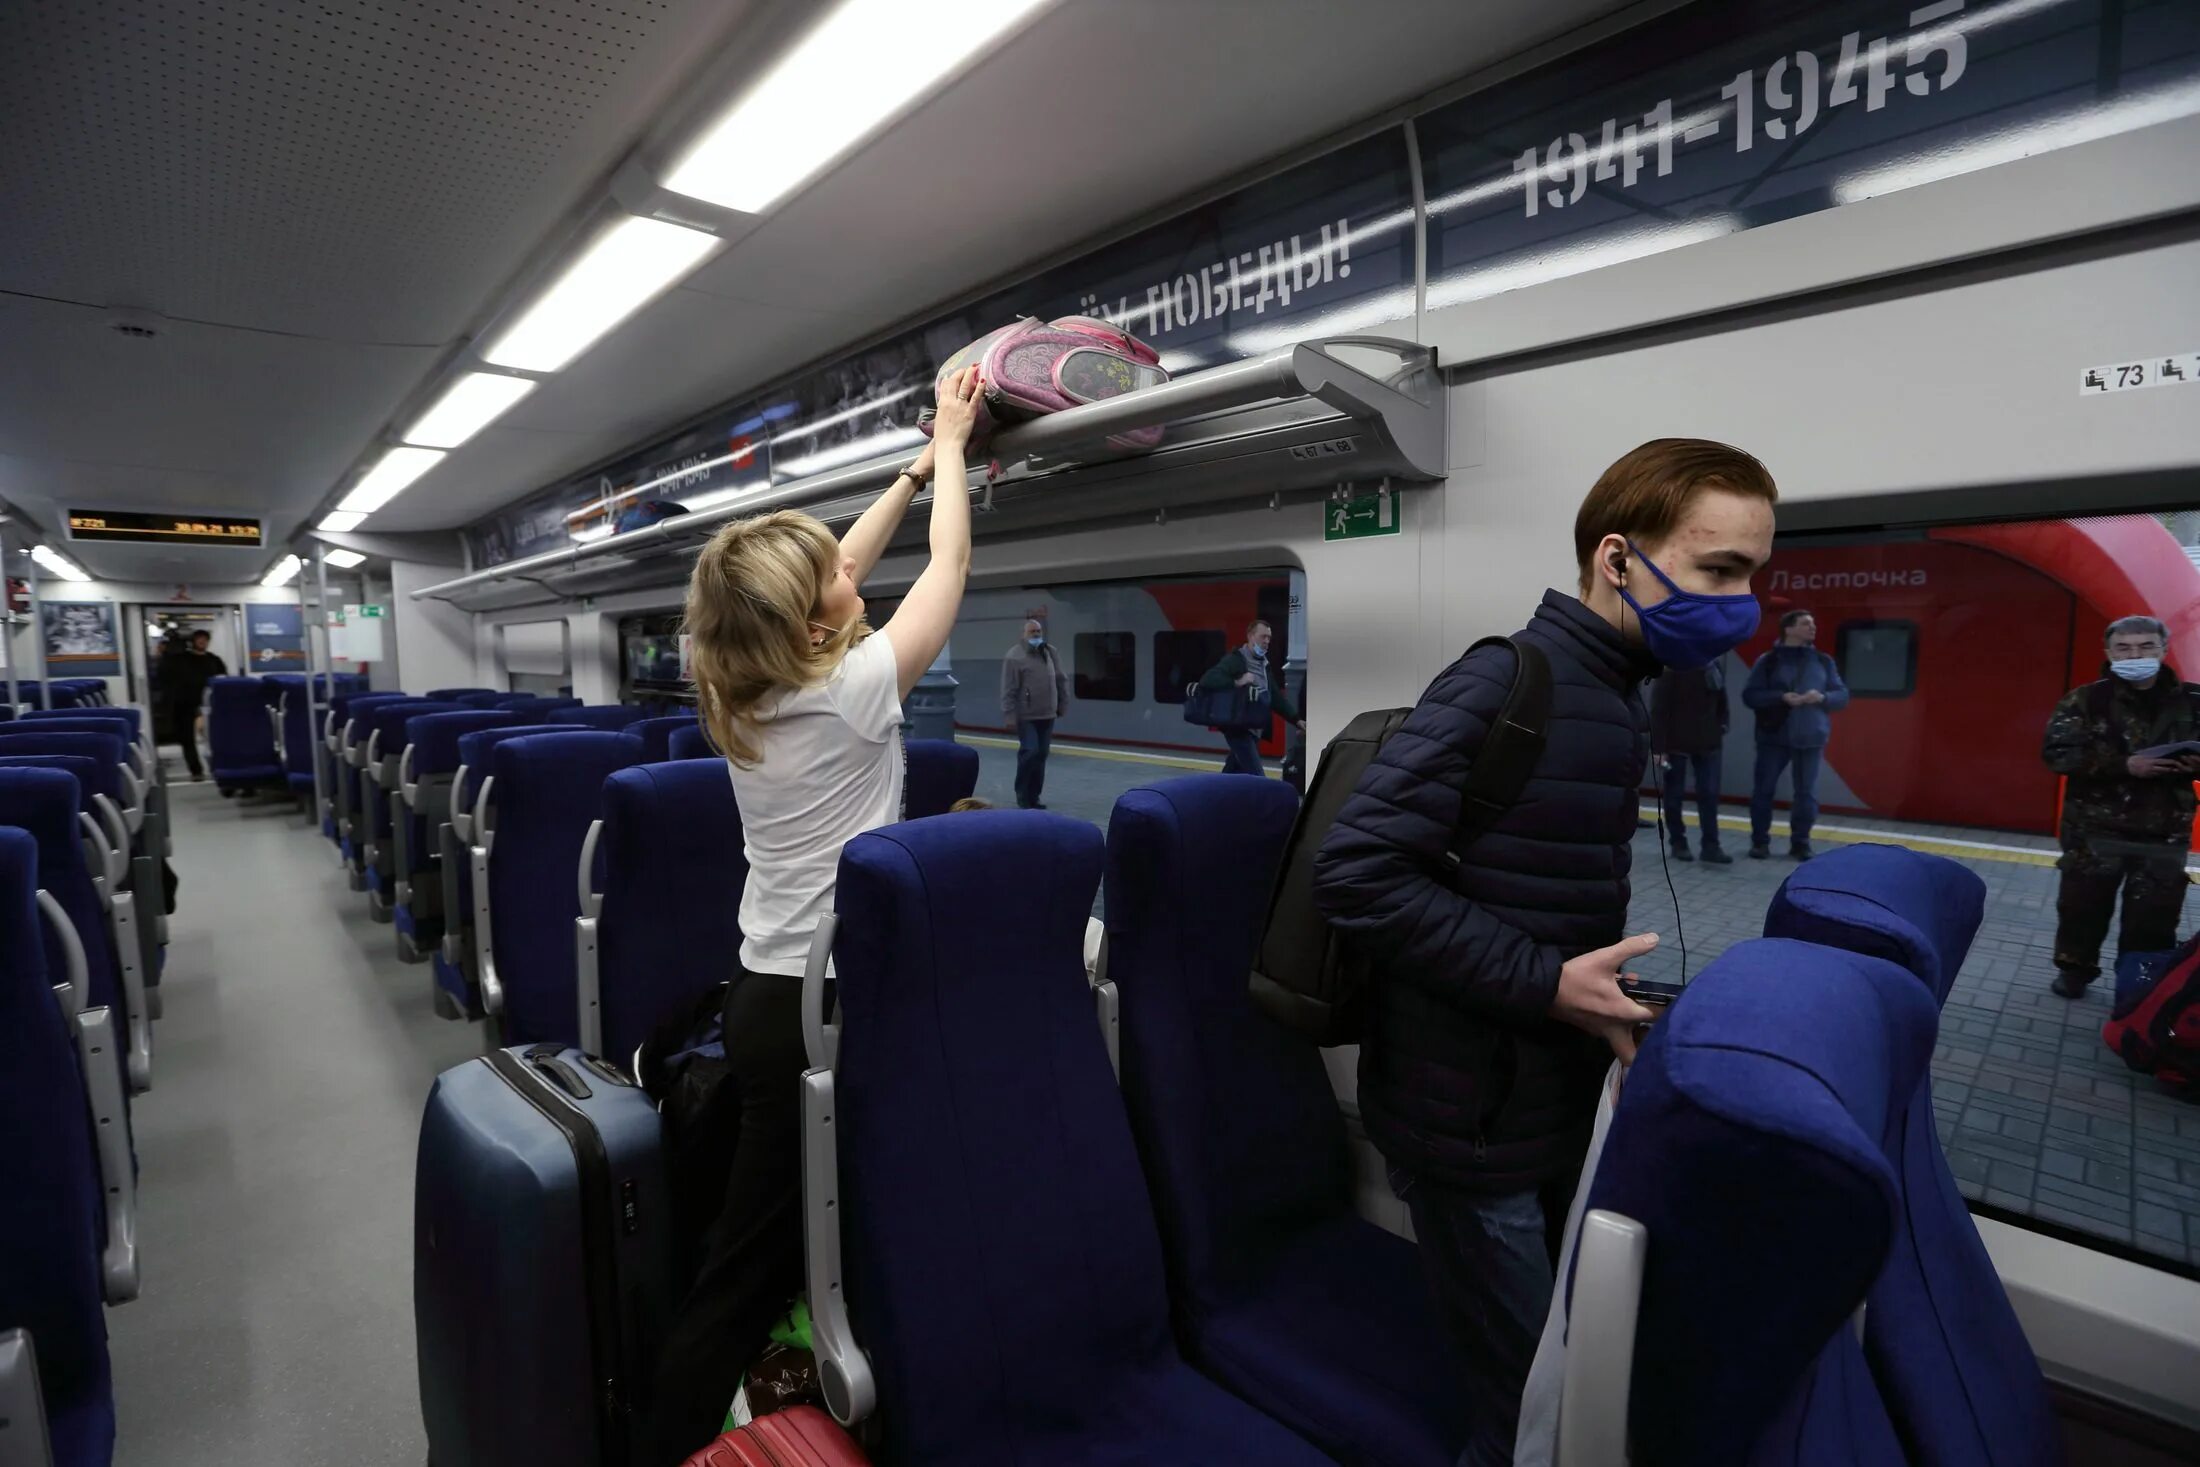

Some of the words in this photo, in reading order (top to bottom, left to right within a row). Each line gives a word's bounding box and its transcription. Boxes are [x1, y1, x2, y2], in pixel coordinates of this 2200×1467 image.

[1513, 0, 1968, 218] 1941-1945
[1146, 218, 1351, 337] ПОБЕДЫ!
[2116, 364, 2144, 388] 73
[1305, 446, 1318, 458] 67
[1336, 440, 1351, 452] 68
[1769, 570, 1927, 590] Ласточка
